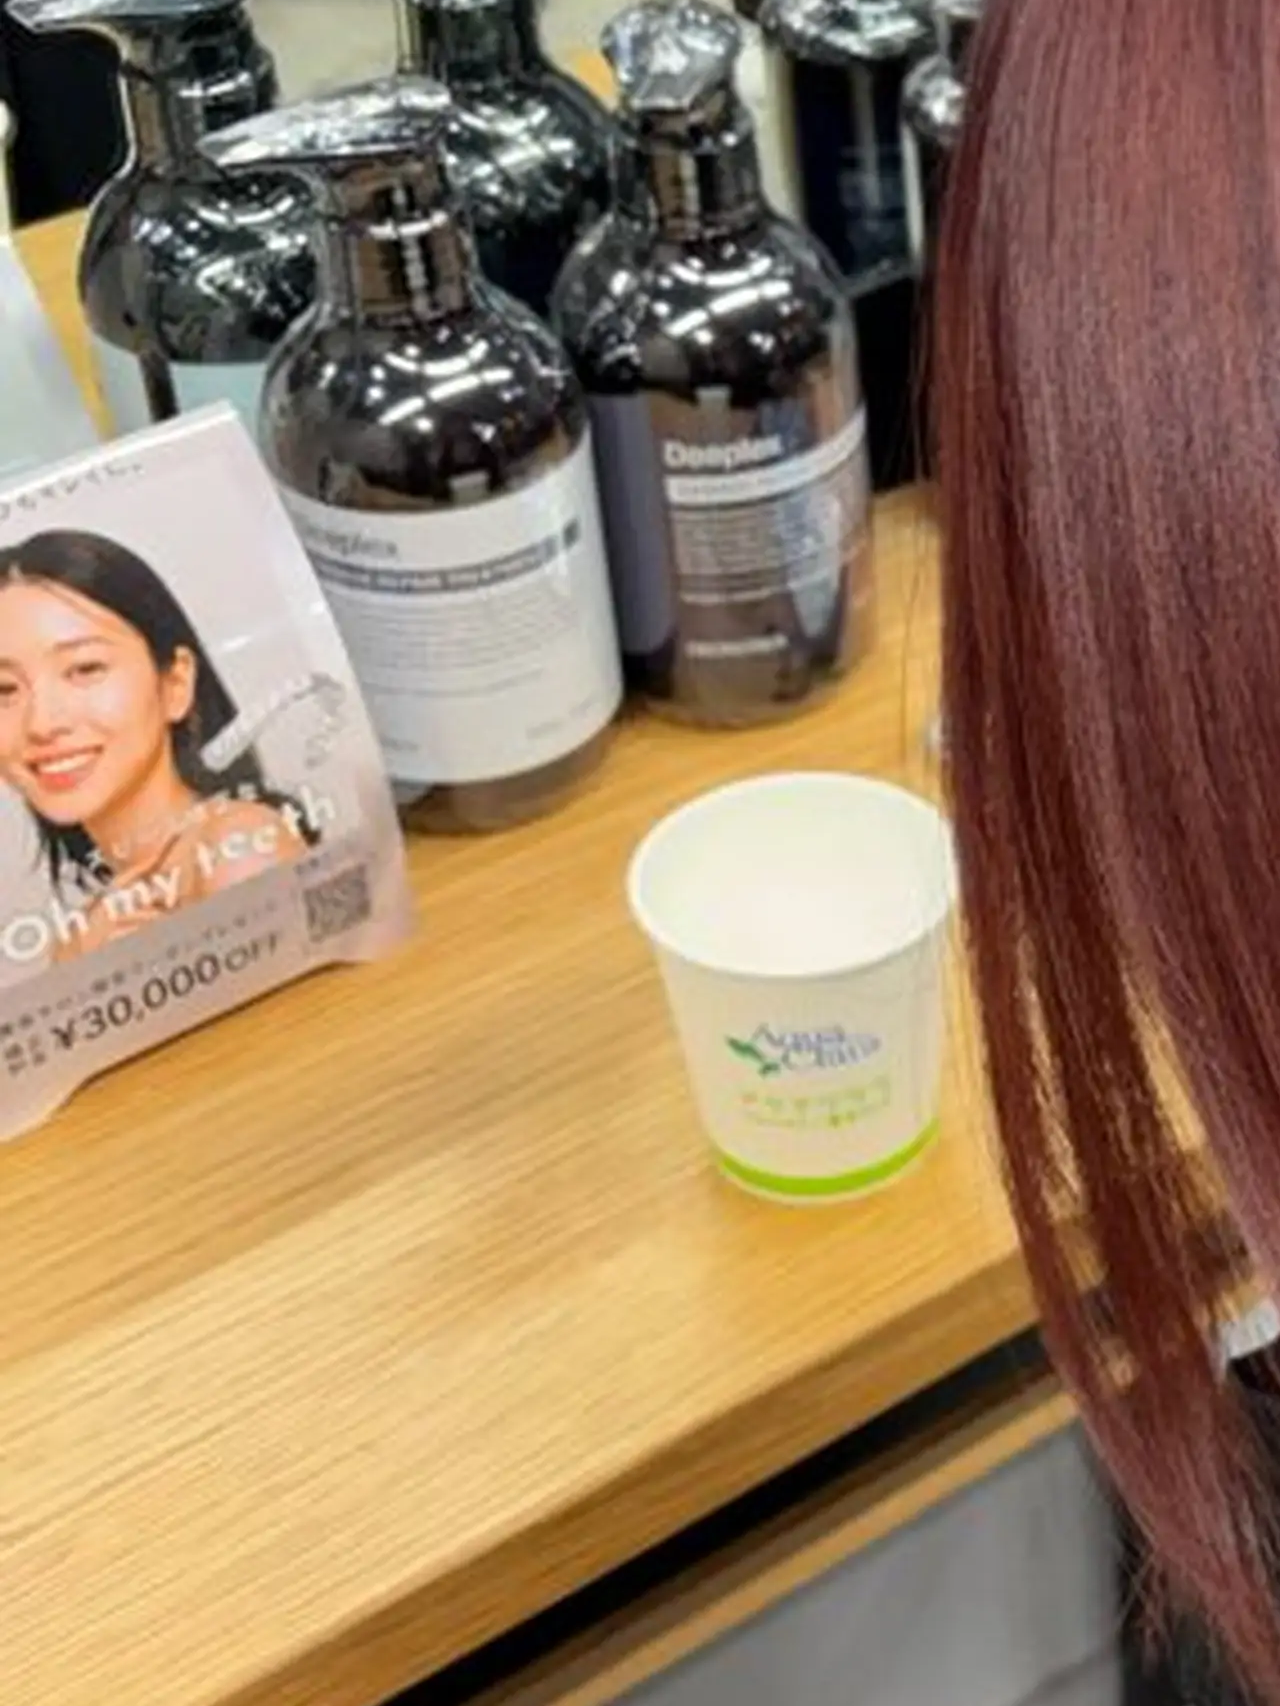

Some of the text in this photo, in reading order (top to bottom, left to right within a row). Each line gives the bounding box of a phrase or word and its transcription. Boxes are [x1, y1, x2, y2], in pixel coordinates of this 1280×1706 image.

[2, 896, 90, 961] Oh
[103, 865, 182, 922] my
[196, 784, 337, 877] teeth
